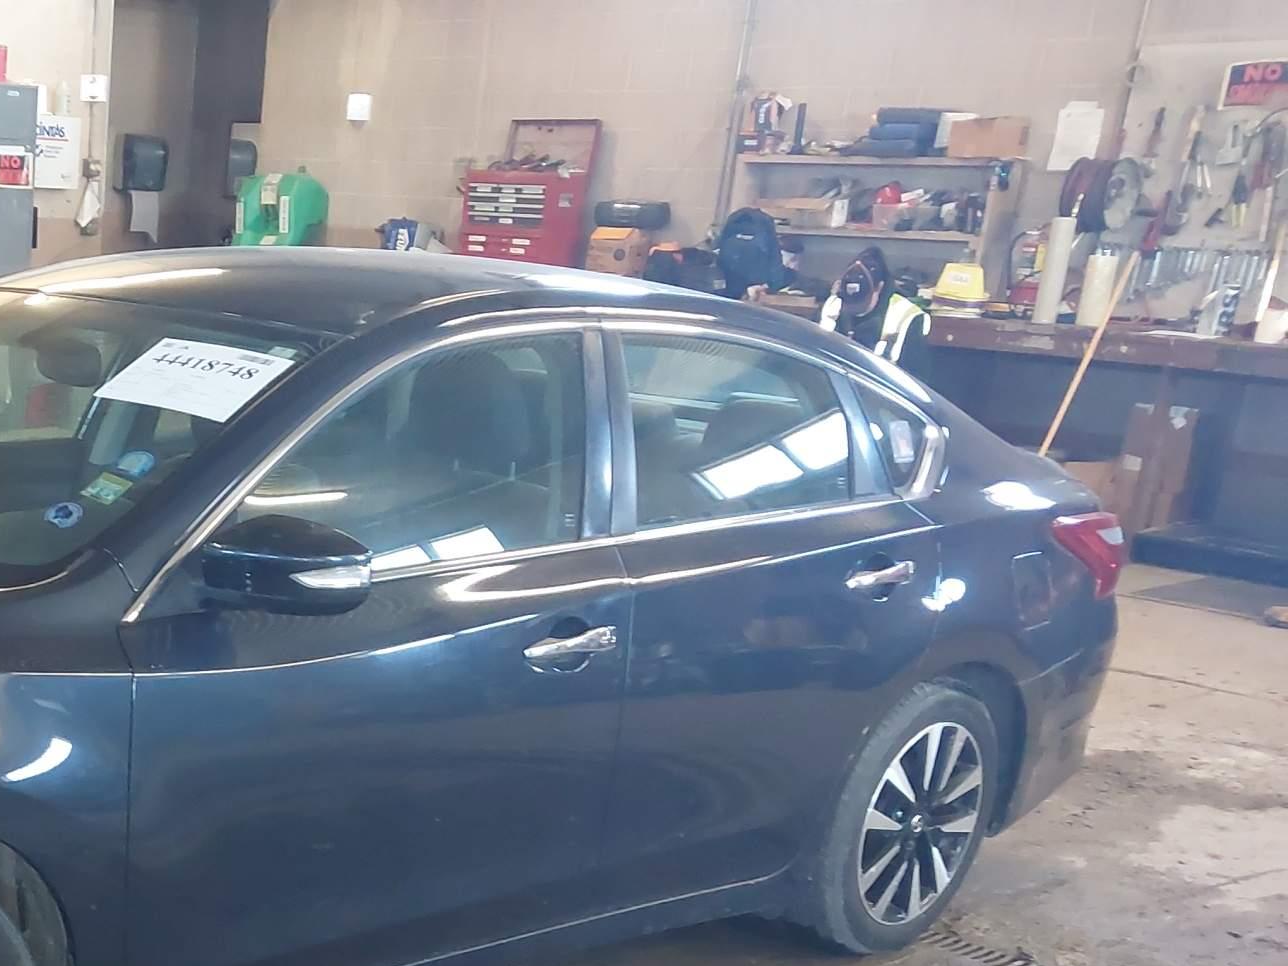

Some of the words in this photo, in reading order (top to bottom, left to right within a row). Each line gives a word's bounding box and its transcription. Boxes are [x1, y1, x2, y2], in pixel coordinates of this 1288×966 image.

[1244, 64, 1282, 82] NO
[0, 155, 21, 169] NO
[152, 353, 258, 380] 44418748
